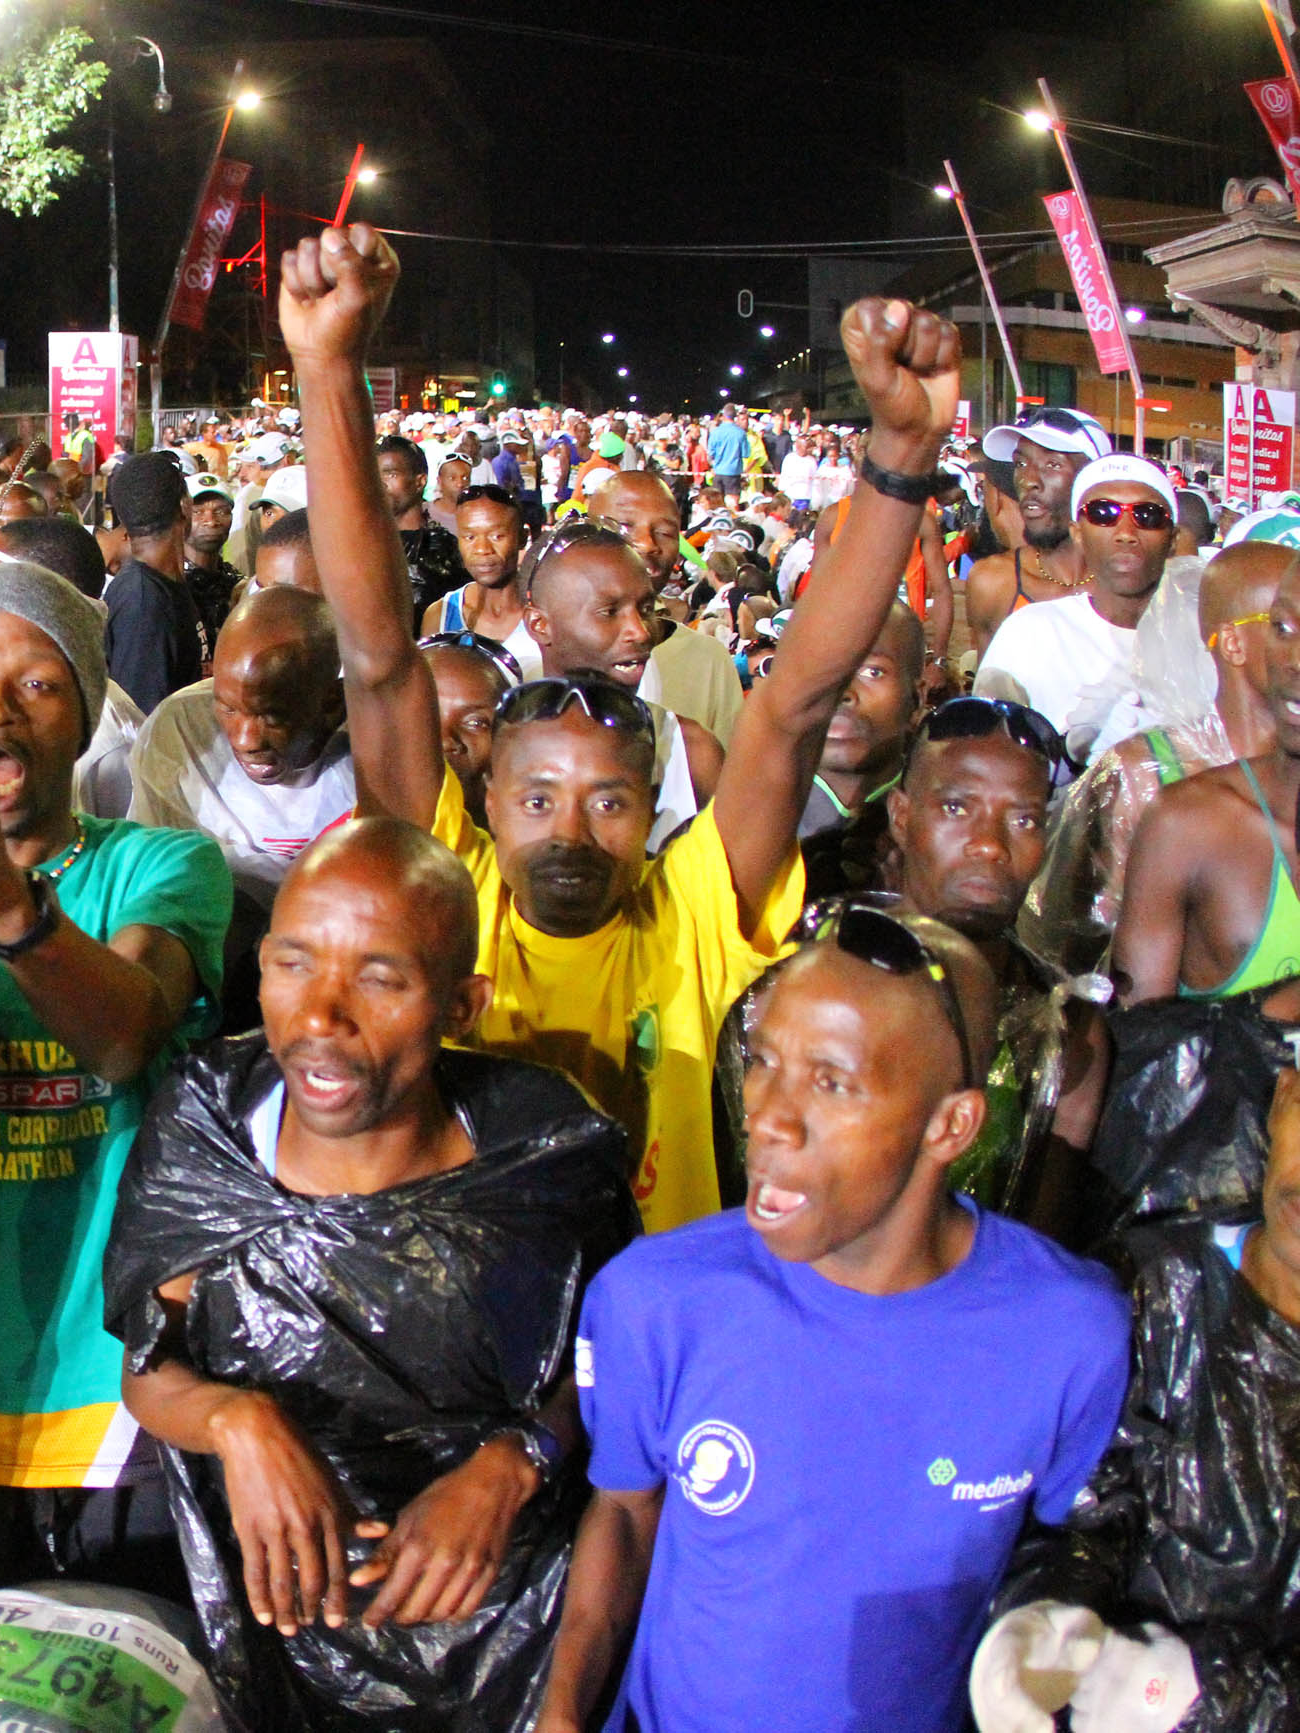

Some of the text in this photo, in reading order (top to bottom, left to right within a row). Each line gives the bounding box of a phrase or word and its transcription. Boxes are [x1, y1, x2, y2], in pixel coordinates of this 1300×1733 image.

[184, 195, 235, 291] Bonitas
[1062, 229, 1115, 332] Bonitas
[72, 337, 99, 364] A
[1234, 385, 1246, 418] A
[1253, 389, 1276, 422] A
[87, 1621, 180, 1676] Runs 10
